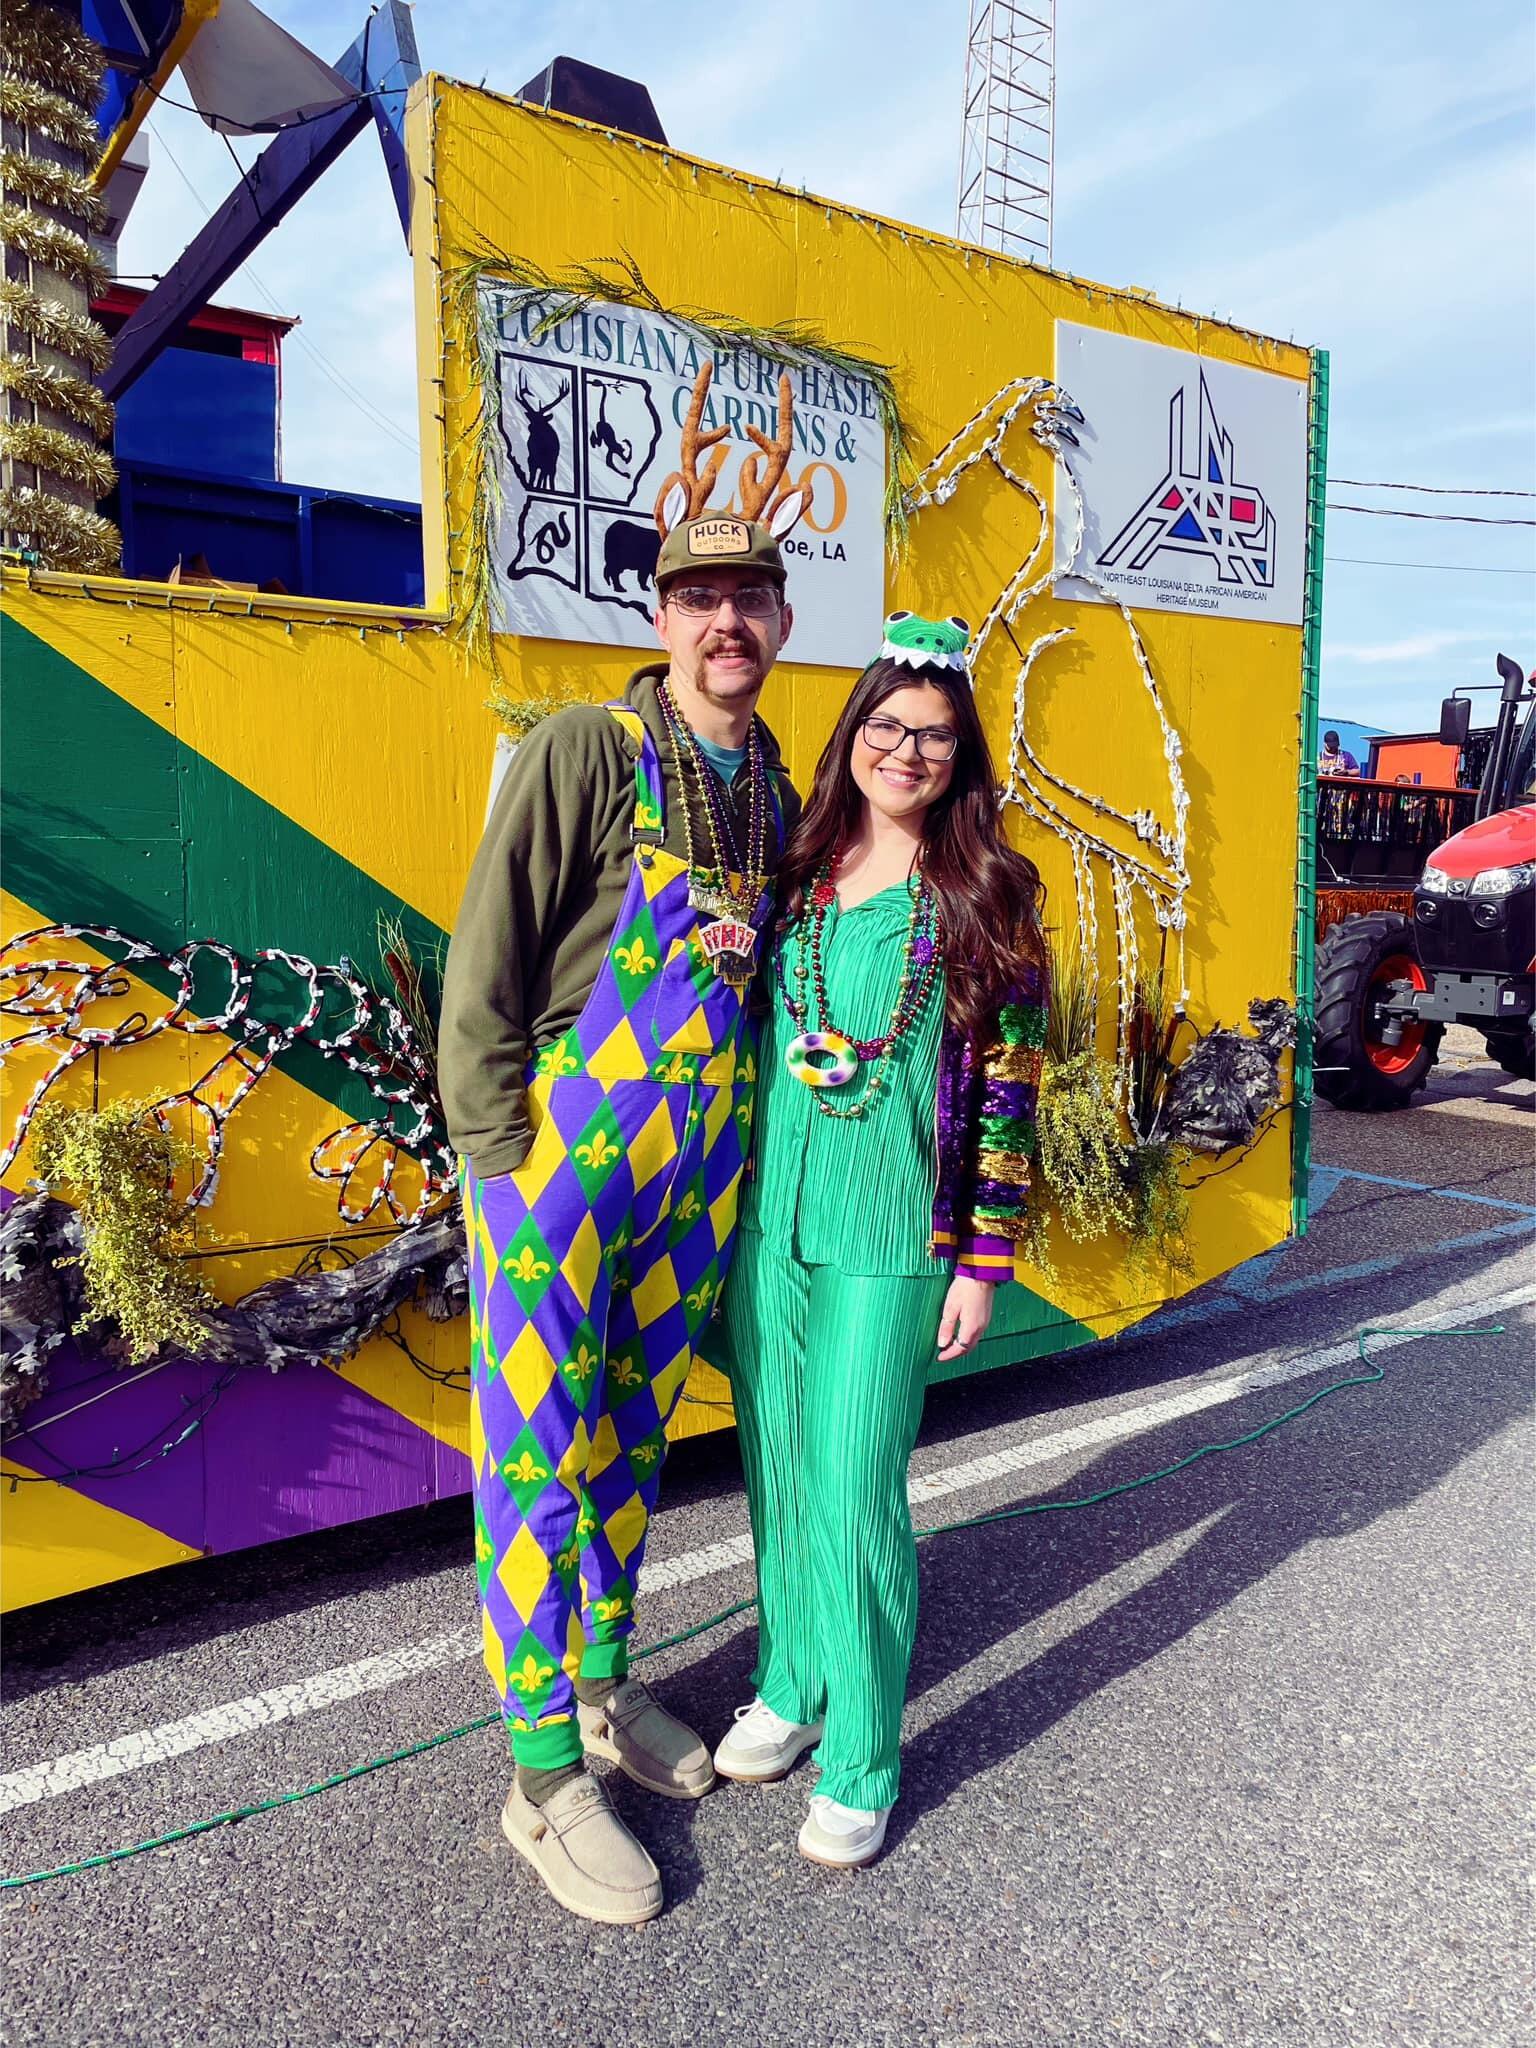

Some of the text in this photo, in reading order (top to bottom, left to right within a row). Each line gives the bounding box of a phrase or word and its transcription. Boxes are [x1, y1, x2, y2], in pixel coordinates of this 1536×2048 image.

[492, 293, 700, 379] LOUISIANA
[835, 421, 857, 463] &
[695, 523, 742, 539] HUCK
[696, 537, 741, 547] OUTDOORS
[822, 540, 847, 562] LA
[1103, 572, 1267, 601] NORTHEAST LOUISIANA DELTA AFRICAN AMERICAN
[1157, 594, 1219, 609] HERITAGE MUSEUM
